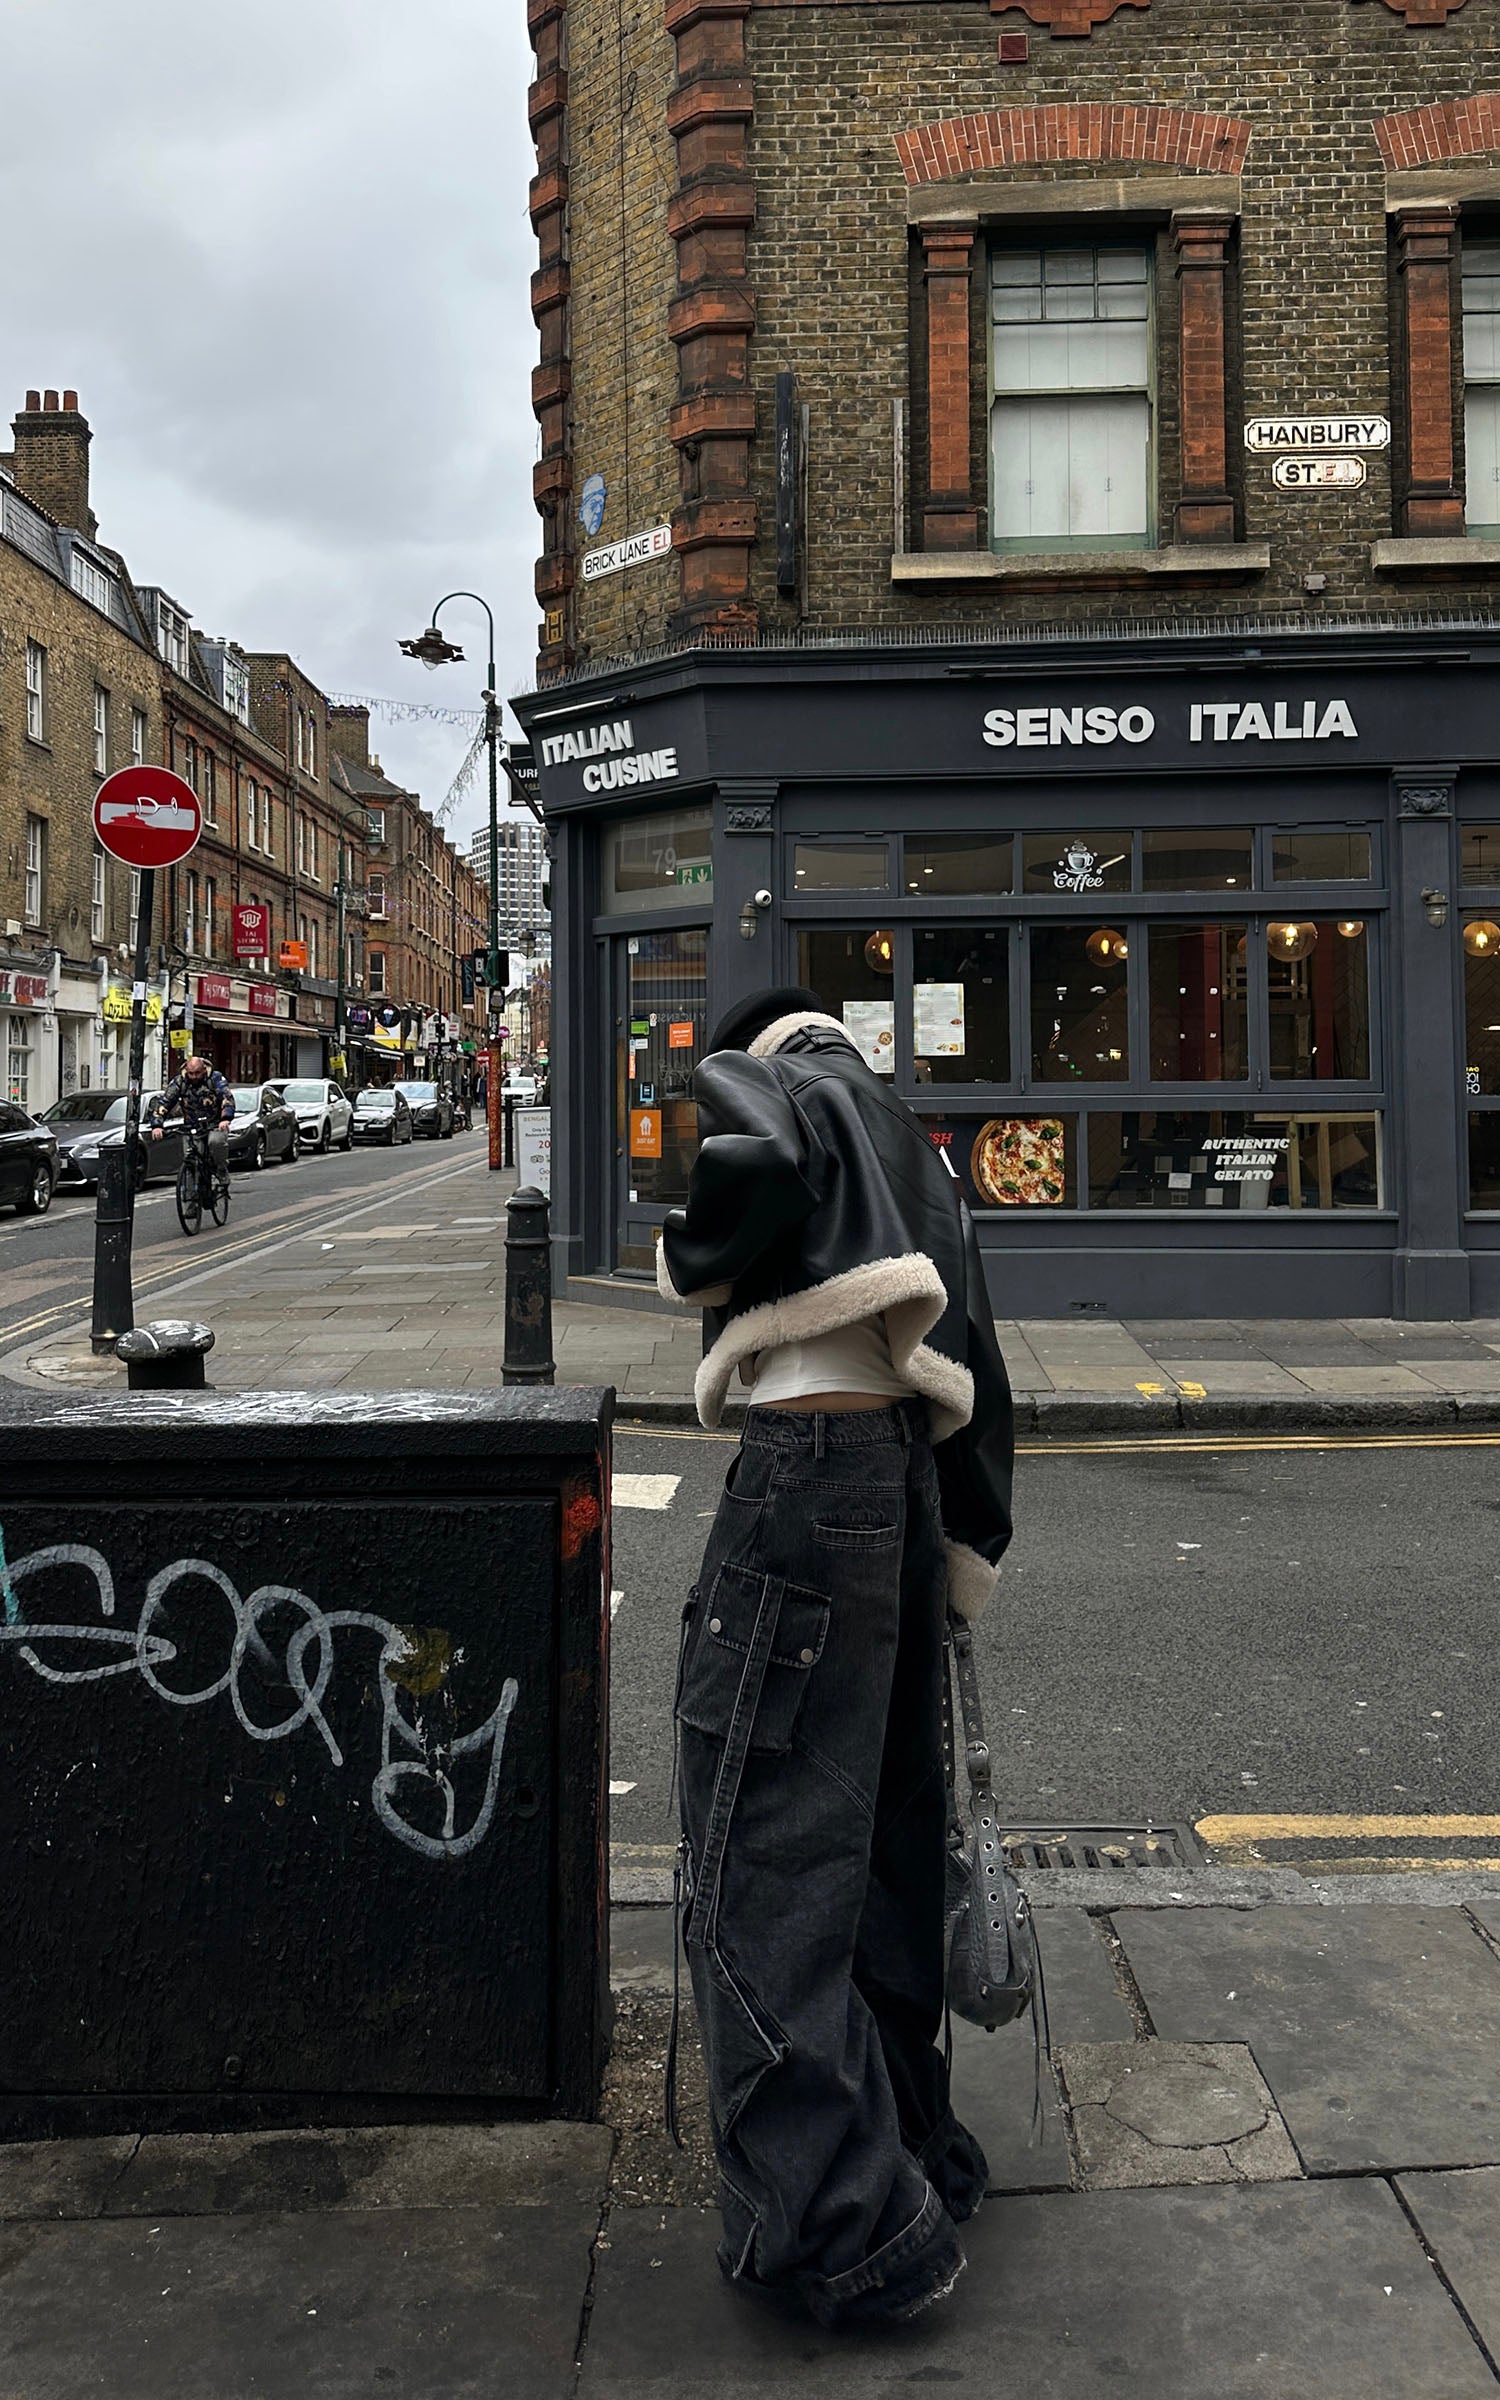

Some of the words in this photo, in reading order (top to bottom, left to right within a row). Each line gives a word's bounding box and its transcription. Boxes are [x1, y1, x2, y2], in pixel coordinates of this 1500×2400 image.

[1258, 423, 1377, 444] HANBURY
[585, 550, 615, 575] BRICK
[620, 538, 650, 563] LANE
[983, 705, 1155, 747] SENSO
[1189, 700, 1358, 742] ITALIA
[541, 719, 635, 767] ITALIAN
[582, 747, 679, 793] CUISINE
[652, 846, 677, 875] 79
[1053, 871, 1104, 892] Coffee
[929, 1133, 953, 1144] SH
[1201, 1138, 1290, 1150] AUTHENTIC
[1215, 1154, 1278, 1165] ITALIAN
[1214, 1169, 1274, 1181] GELATO
